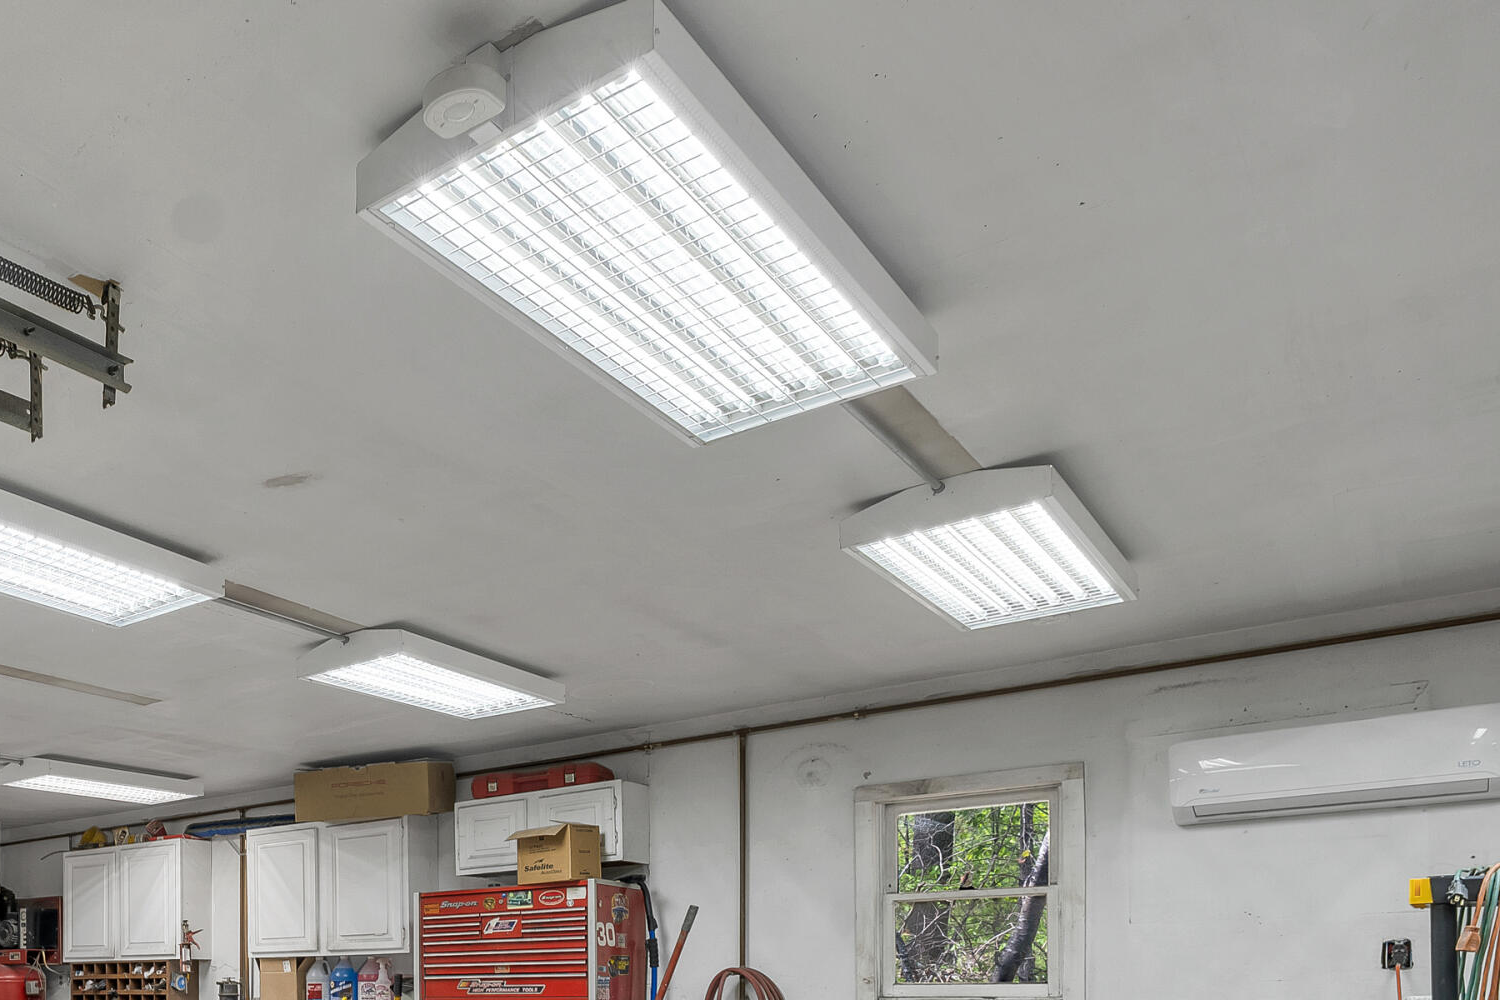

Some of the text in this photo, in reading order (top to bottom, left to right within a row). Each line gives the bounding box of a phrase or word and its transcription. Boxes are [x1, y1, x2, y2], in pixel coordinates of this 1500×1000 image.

[524, 863, 554, 872] Safelite
[440, 900, 478, 910] Snap-on
[596, 922, 616, 947] 30
